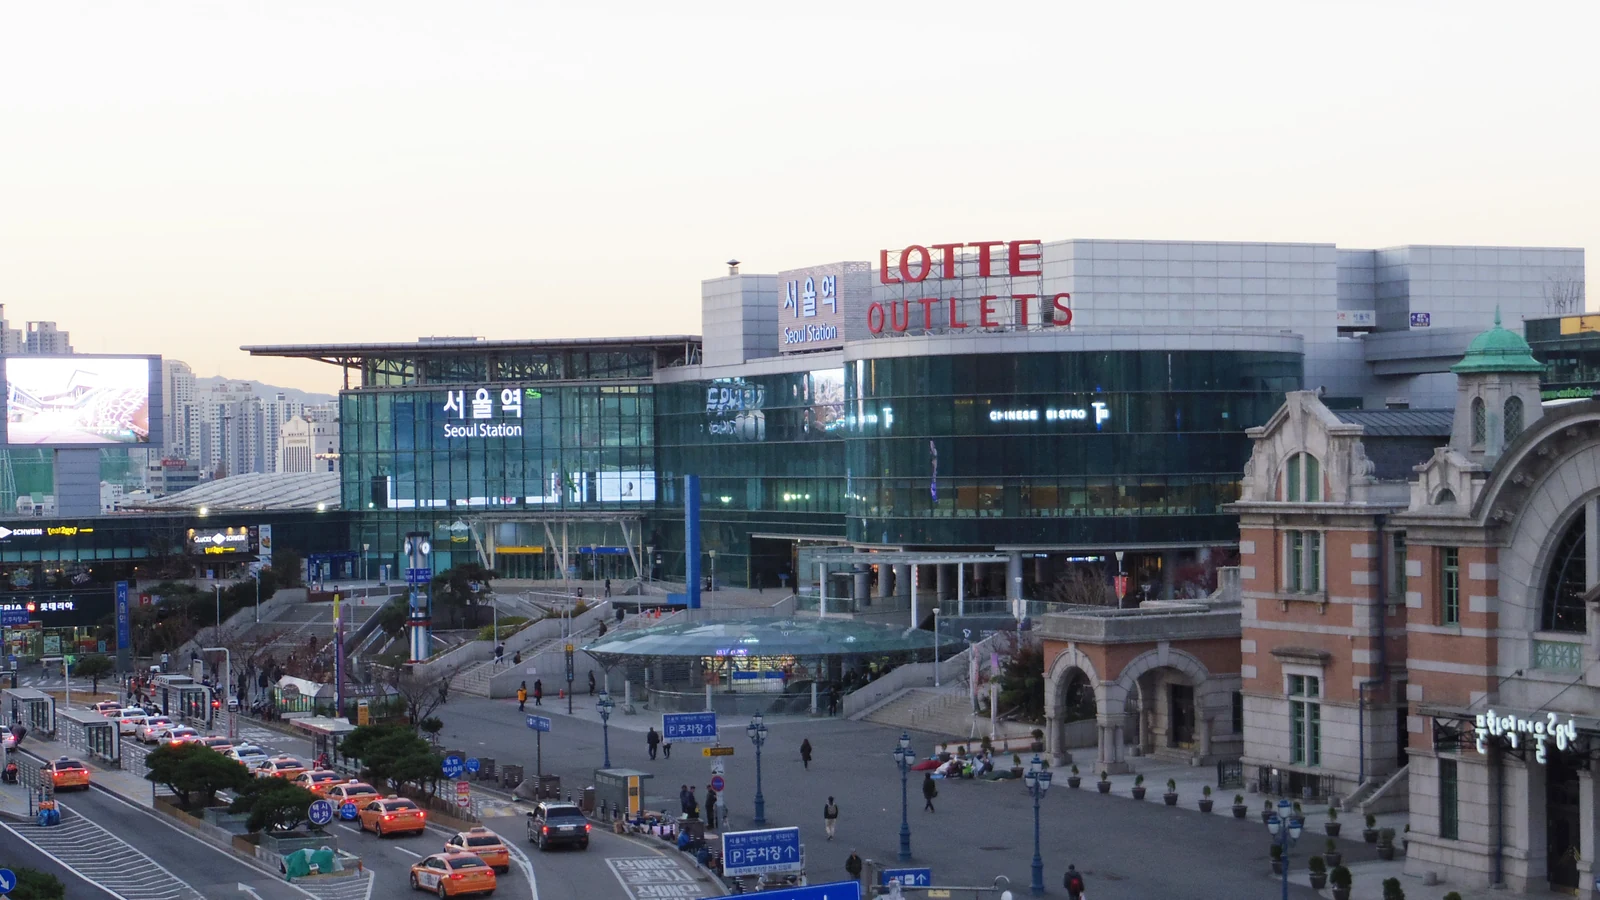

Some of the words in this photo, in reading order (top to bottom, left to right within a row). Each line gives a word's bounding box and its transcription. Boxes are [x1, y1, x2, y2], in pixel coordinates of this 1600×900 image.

[880, 240, 1041, 284] LOTTE
[784, 275, 837, 318] 서울역
[867, 293, 1073, 334] OUTLETS
[784, 325, 807, 344] Seoul
[807, 323, 837, 342] Station
[443, 388, 522, 419] 서울역
[989, 409, 1038, 421] CHINESE
[1046, 408, 1086, 420] BISTRO
[443, 423, 477, 437] Seoul
[480, 423, 522, 437] Station
[13, 528, 42, 536] SCHWEIN
[40, 602, 74, 611] 롯데리아
[678, 724, 703, 734] 주차장
[312, 811, 329, 819] 하차
[733, 851, 741, 862] P
[745, 846, 781, 862] 주차장
